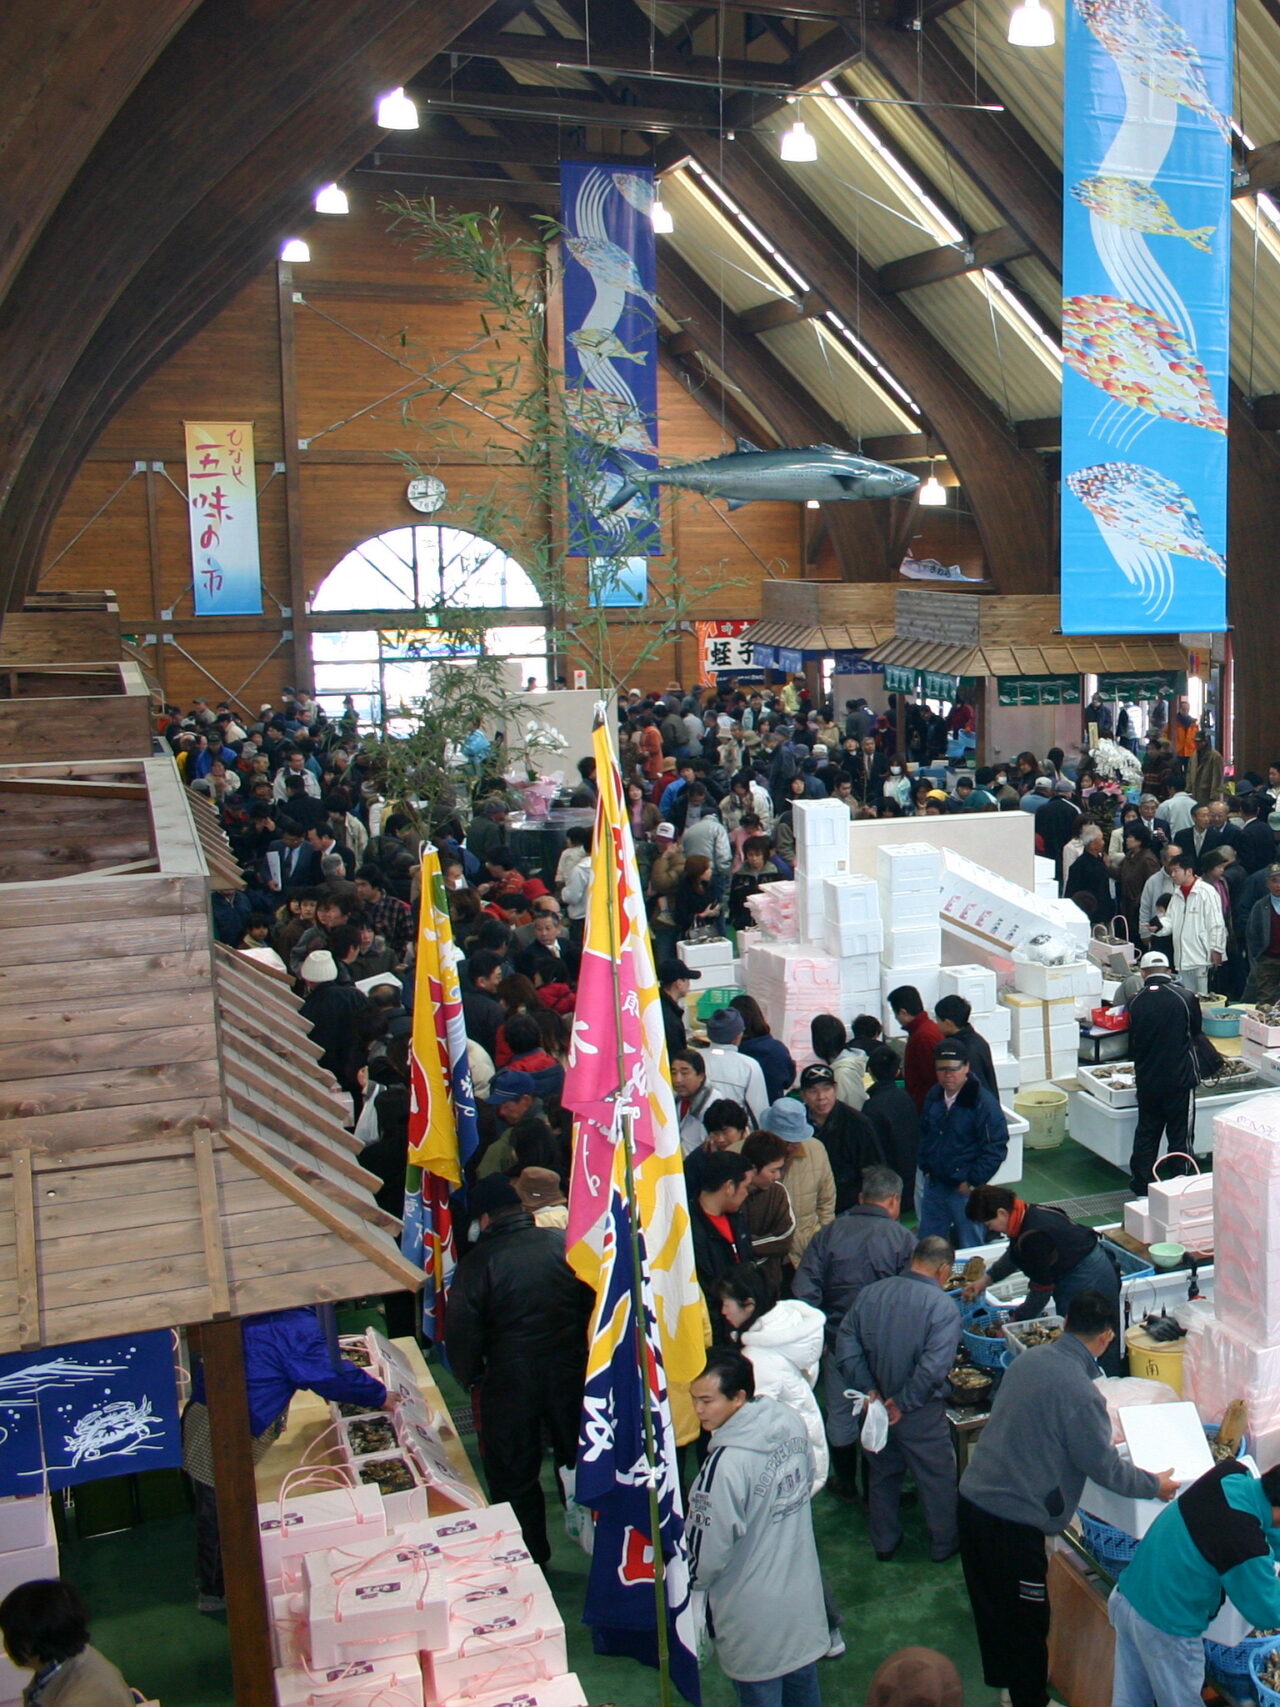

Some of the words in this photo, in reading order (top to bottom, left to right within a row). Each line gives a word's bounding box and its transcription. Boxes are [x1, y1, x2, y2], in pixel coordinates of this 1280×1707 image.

[226, 429, 247, 488] ひなせ
[189, 444, 234, 599] 五味の市
